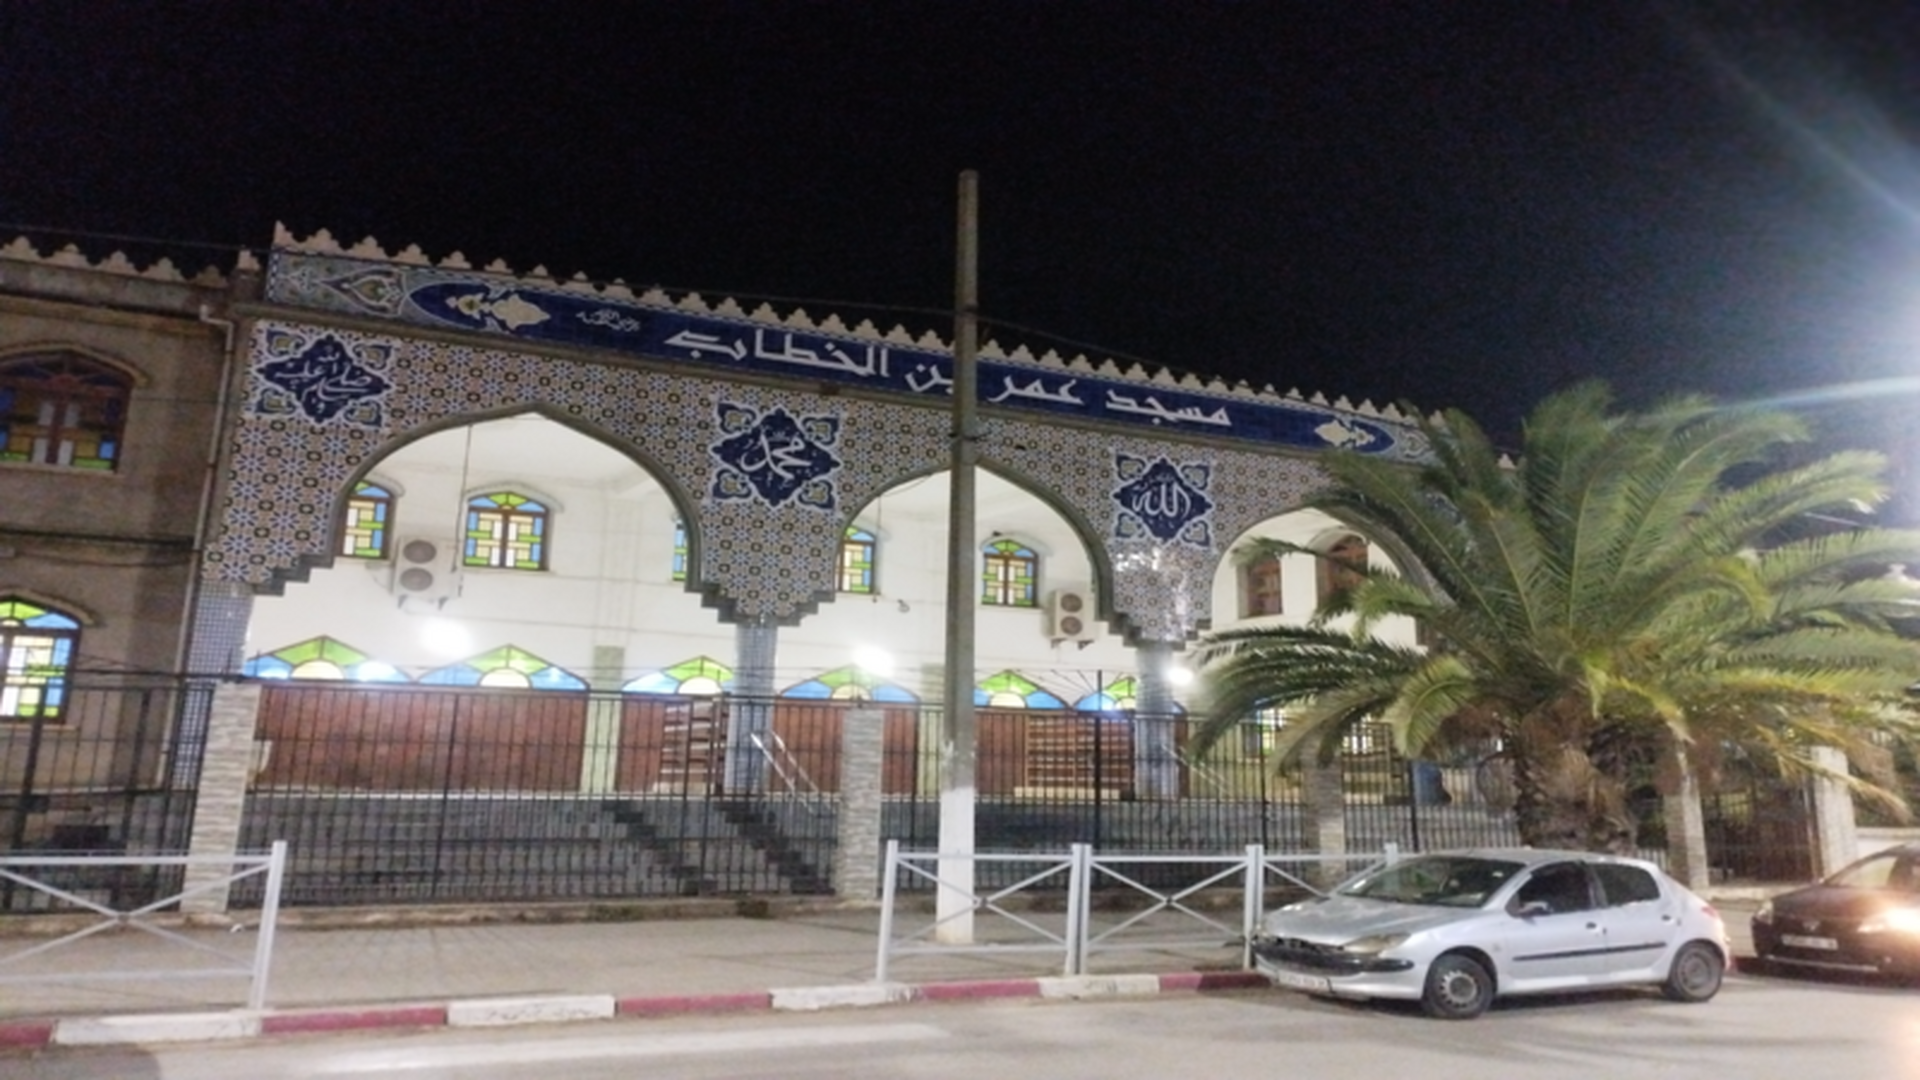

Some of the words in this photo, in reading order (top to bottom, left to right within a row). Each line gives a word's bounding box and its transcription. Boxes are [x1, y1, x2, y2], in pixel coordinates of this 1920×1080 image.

[664, 328, 889, 377] الخطاب
[988, 375, 1084, 405] عمر
[1106, 389, 1232, 426] مسجد
[741, 431, 812, 479] محمد
[1132, 483, 1191, 520] الله
